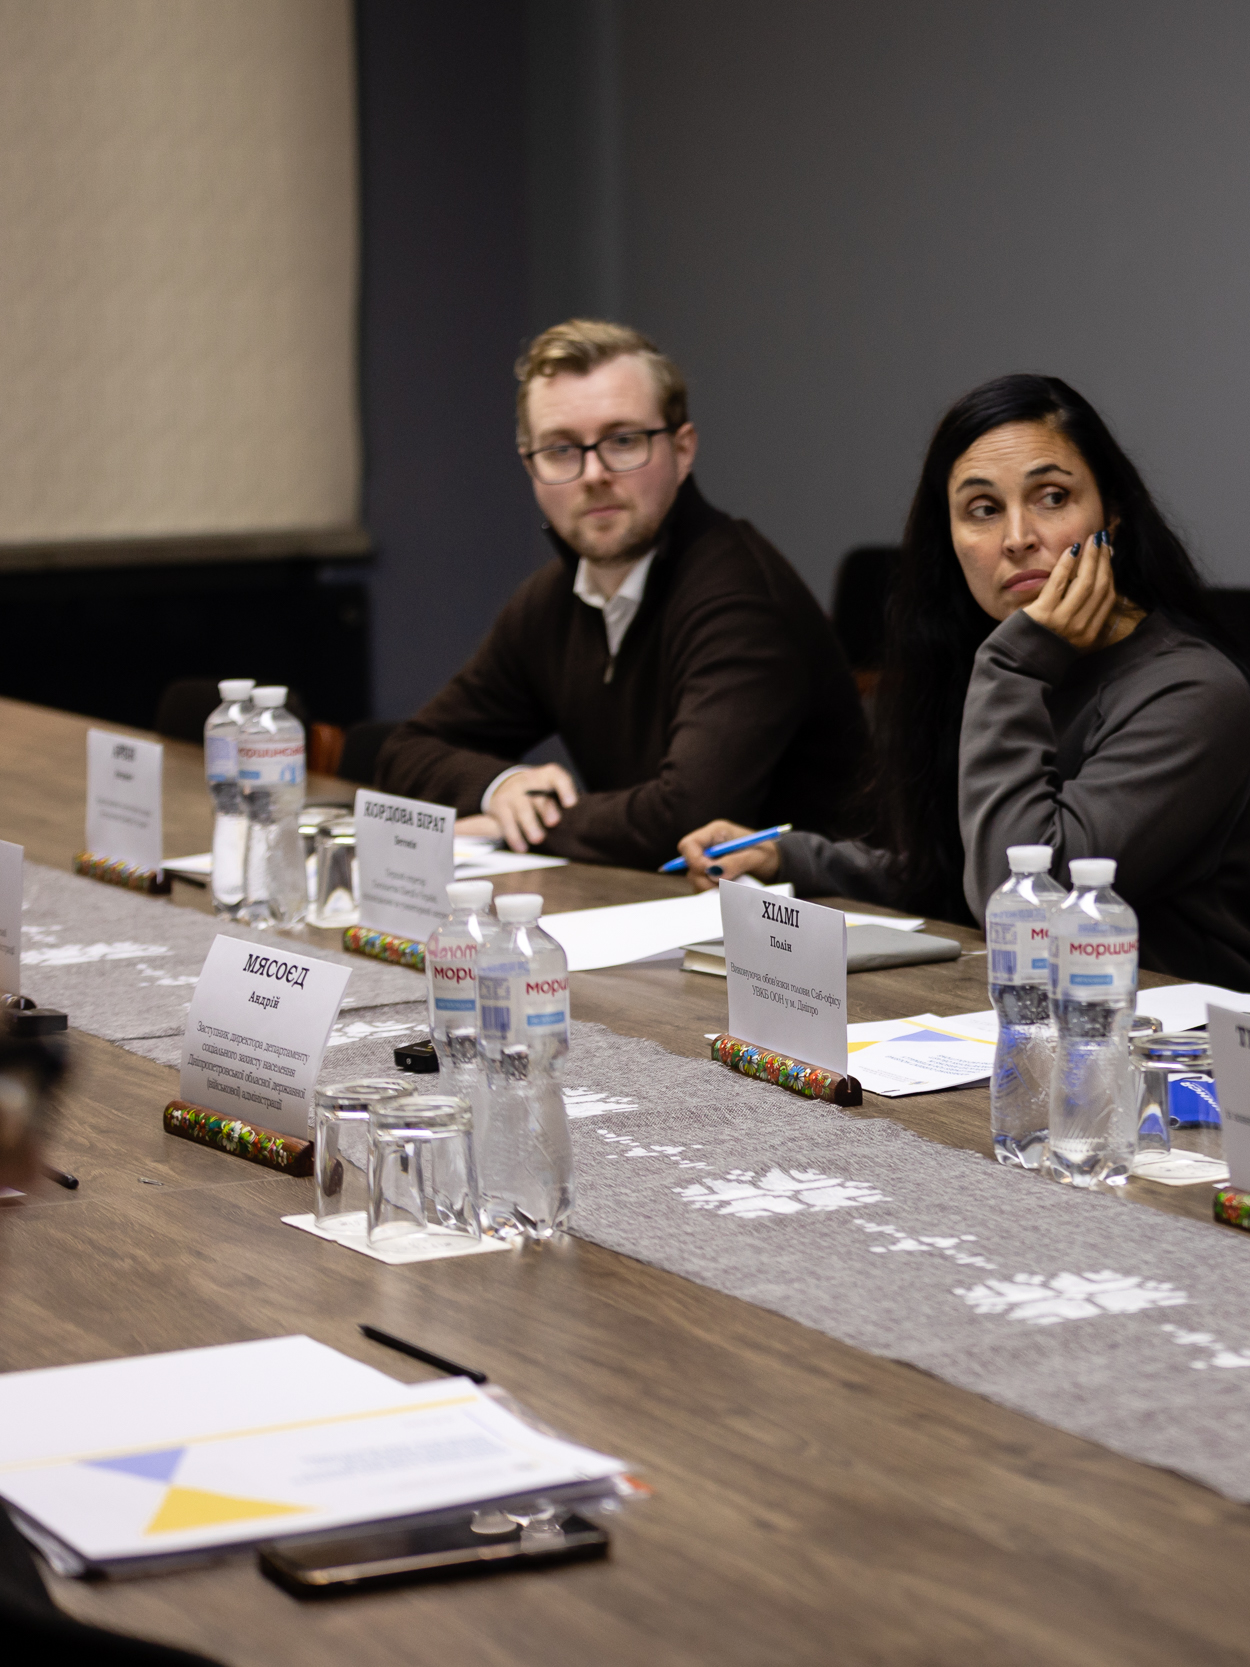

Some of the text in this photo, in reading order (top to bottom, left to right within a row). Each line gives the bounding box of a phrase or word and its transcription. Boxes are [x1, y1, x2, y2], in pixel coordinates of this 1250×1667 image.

[363, 801, 414, 826] КОРДОВА
[762, 900, 799, 928] ХІЛМІ
[770, 935, 792, 952] Полін
[243, 953, 310, 990] МЯСОЄД
[730, 961, 761, 982] Виконуюча
[790, 984, 811, 998] голови
[810, 988, 842, 1009] Саб-офісу
[248, 991, 281, 1010] Андрій
[751, 985, 769, 1000] УВКБ
[769, 991, 784, 1005] ООН
[796, 999, 819, 1017] Дніпро
[196, 1020, 310, 1065] Заступник директора департаменту
[187, 1053, 307, 1099] Дніпропетровської обласної державної
[202, 1042, 297, 1078] соціального захисту населення
[241, 1090, 283, 1111] адміністрації
